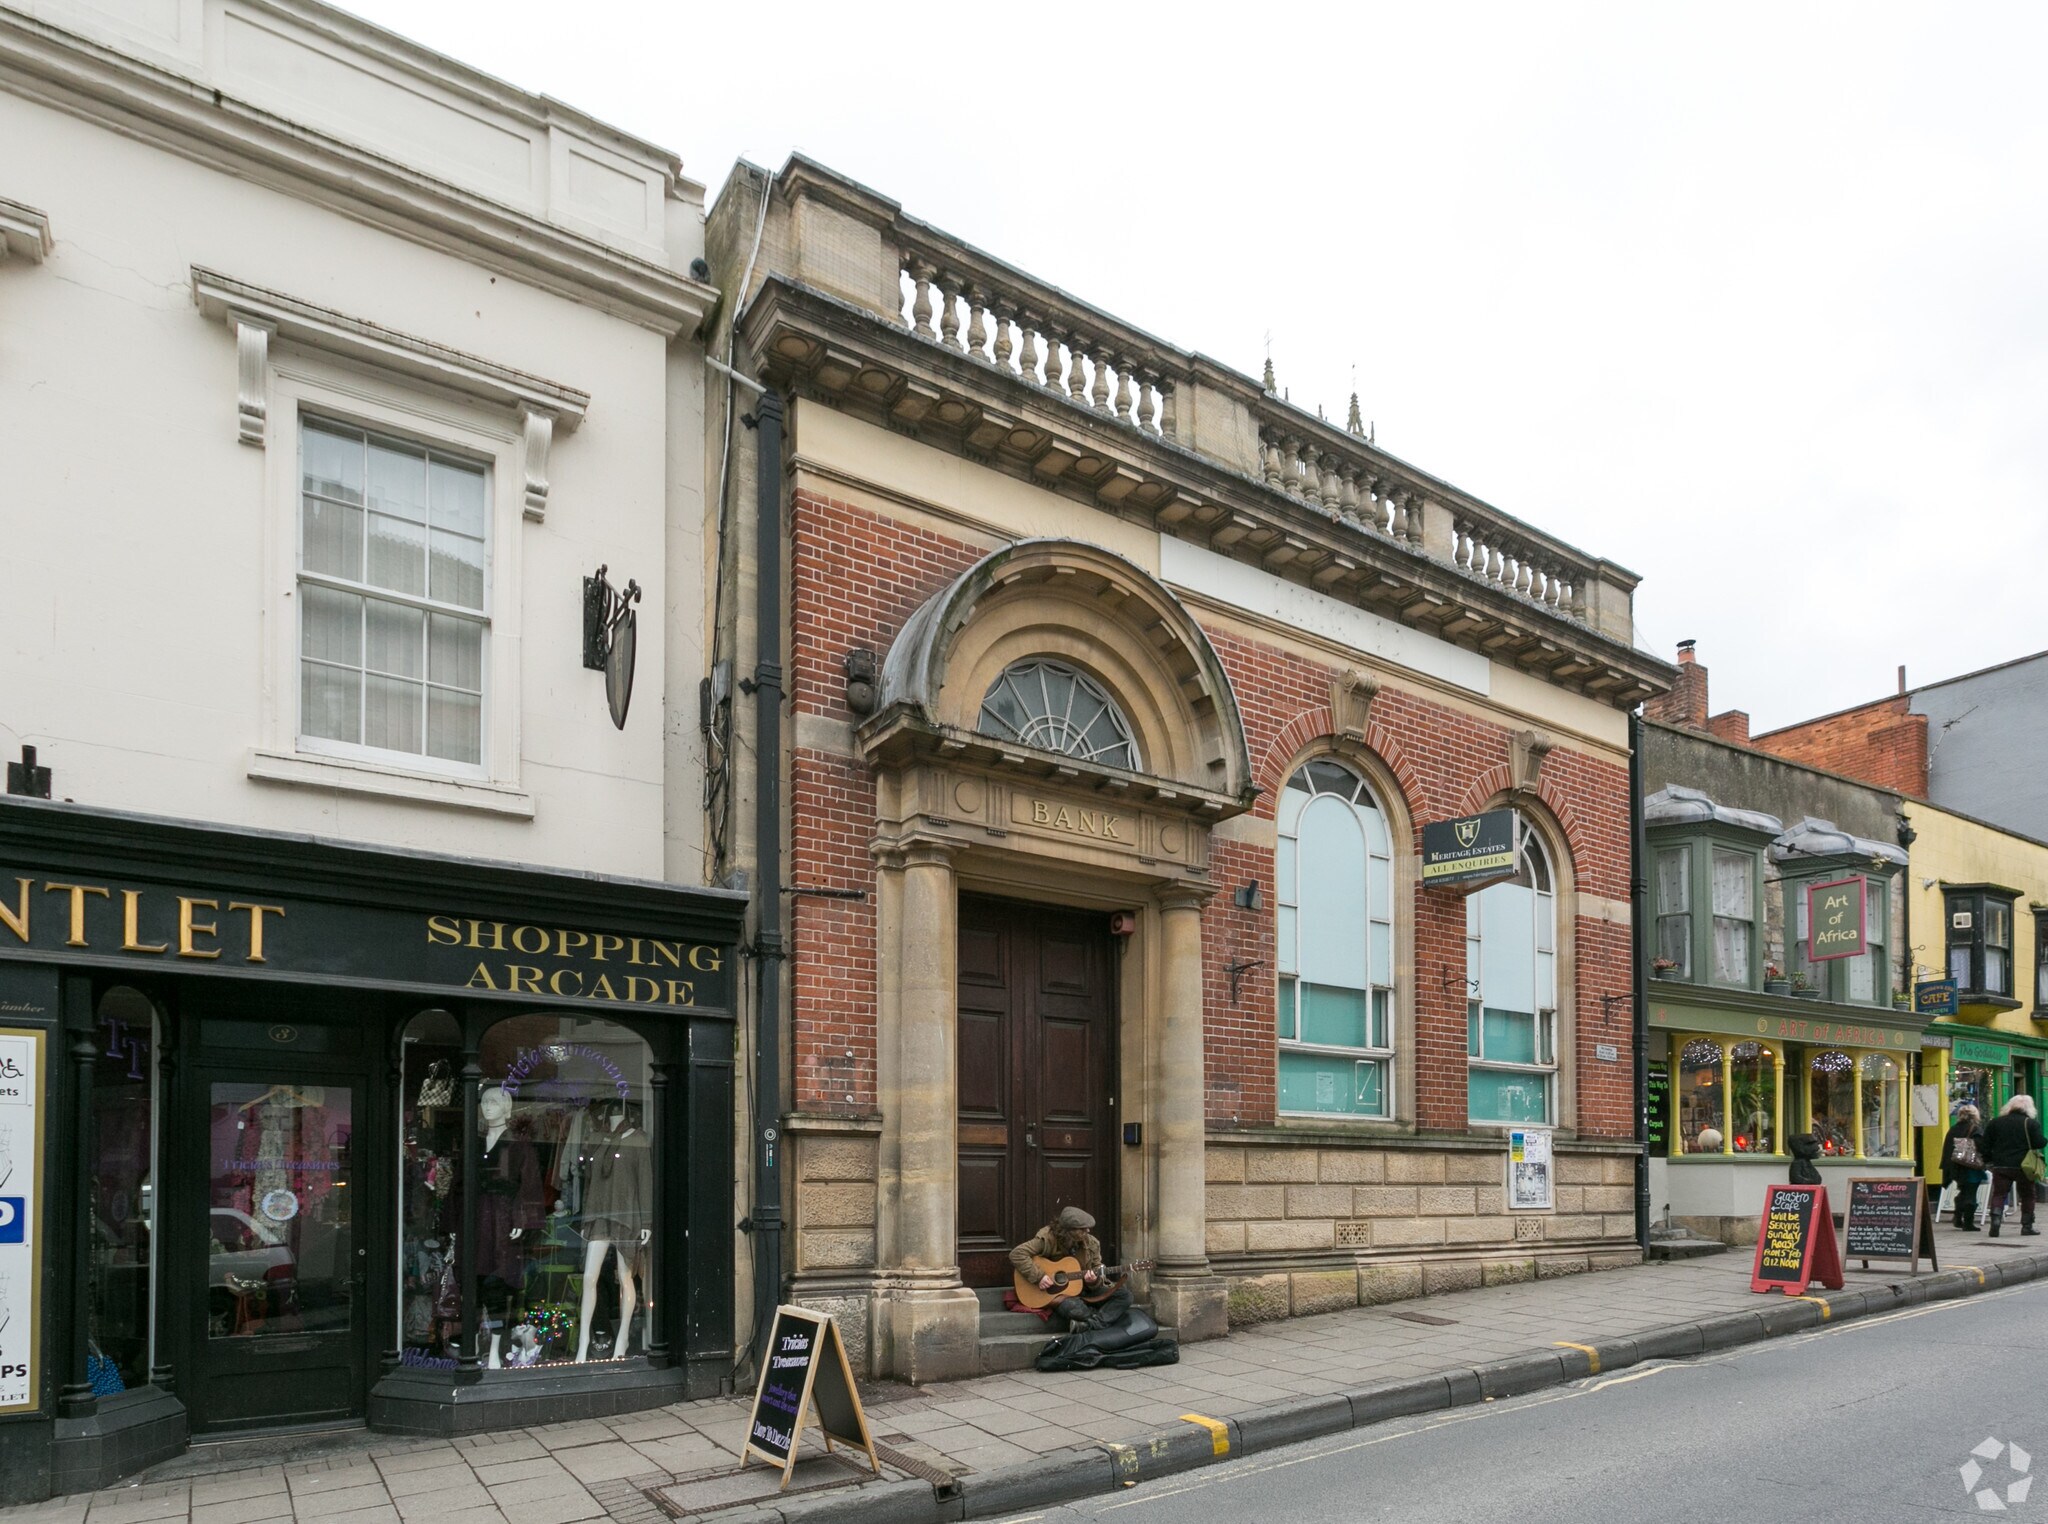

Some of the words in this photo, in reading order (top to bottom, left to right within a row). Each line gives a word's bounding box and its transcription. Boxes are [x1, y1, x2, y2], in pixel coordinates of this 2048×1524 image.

[1032, 800, 1119, 838] BANK
[1431, 849, 1471, 862] HERITAGE
[1472, 843, 1506, 855] ESTATES
[1431, 865, 1449, 874] ALL
[1452, 856, 1507, 870] ENQUIRIES
[1824, 894, 1849, 910] Art
[1828, 911, 1844, 925] of
[427, 915, 725, 972] SHOPPING
[1816, 929, 1857, 945] Africa
[465, 961, 695, 1007] ARCADE
[1920, 992, 1951, 1005] CAFE
[1777, 1018, 1808, 1038] ART
[1813, 1022, 1830, 1040] of
[1834, 1024, 1886, 1046] AFRICA
[1877, 1183, 1907, 1193] Glastro
